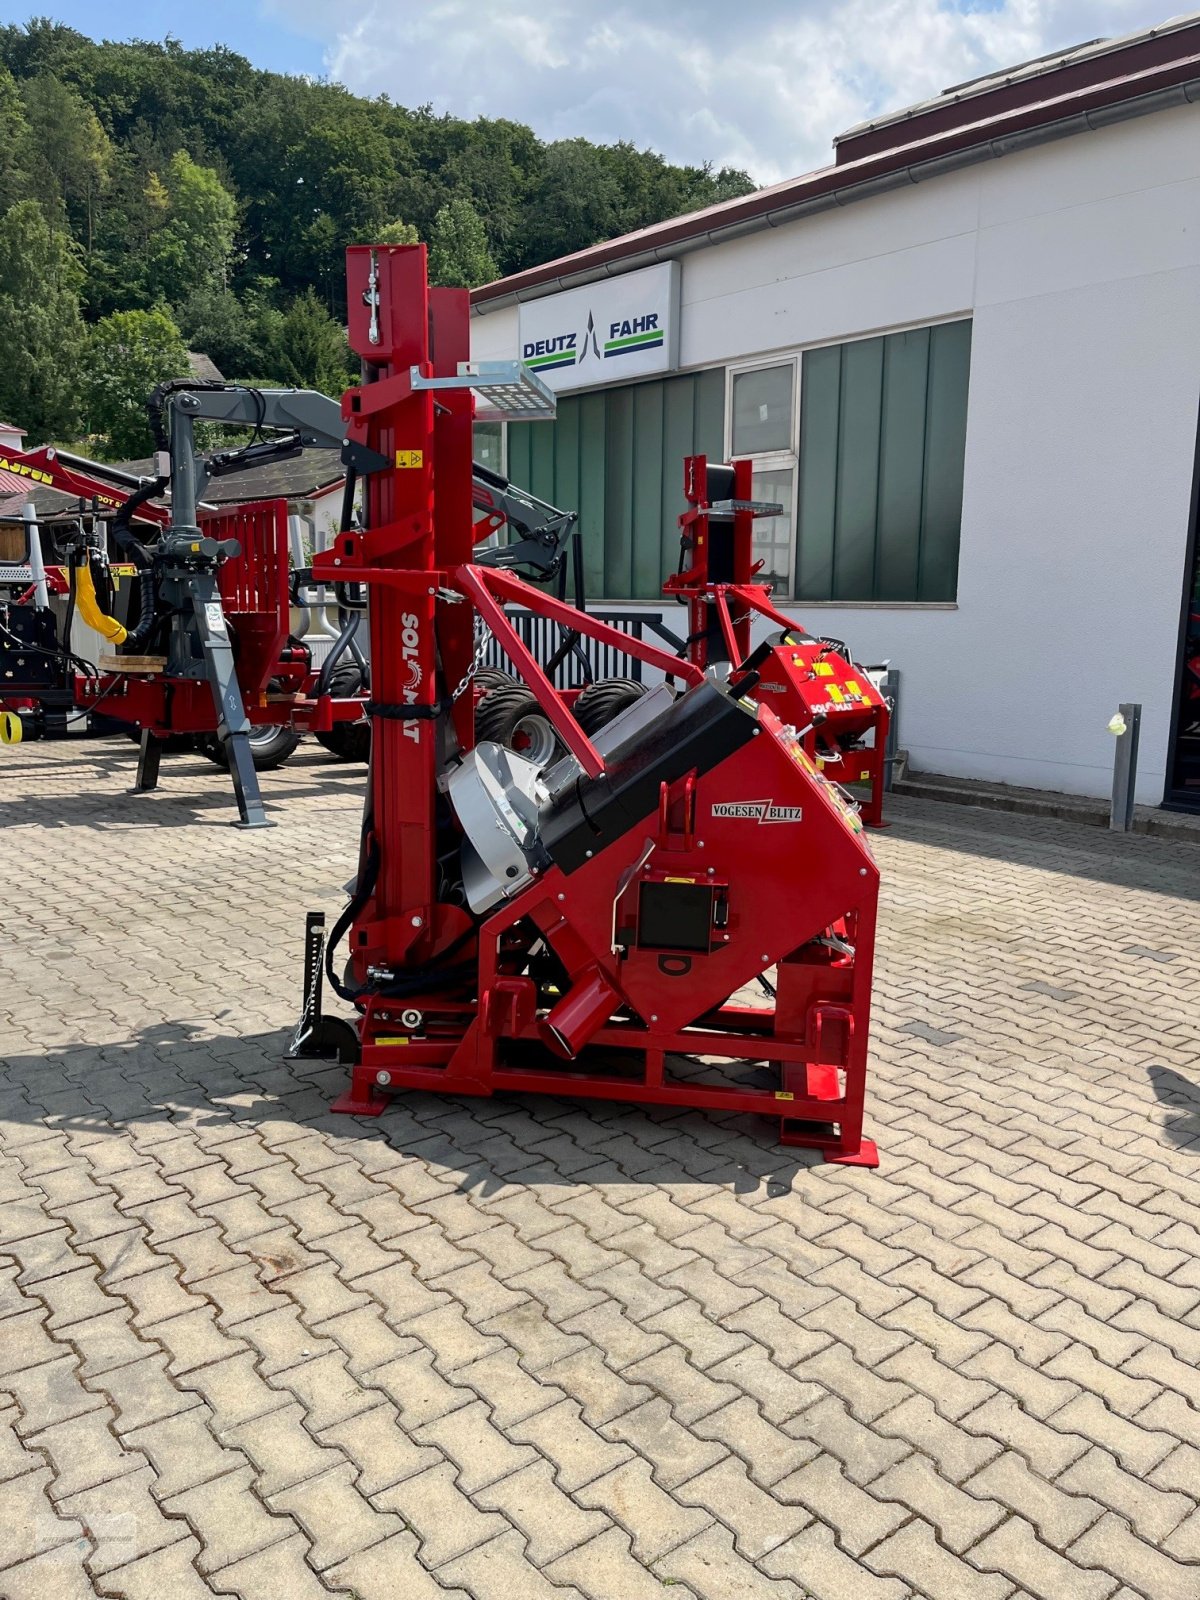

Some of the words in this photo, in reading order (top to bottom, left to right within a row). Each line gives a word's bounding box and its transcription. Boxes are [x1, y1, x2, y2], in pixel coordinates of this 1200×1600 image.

[523, 333, 577, 359] DEUTZ
[609, 313, 659, 339] FAHR
[713, 805, 763, 817] VOGESEN
[769, 807, 801, 819] BLITZ
